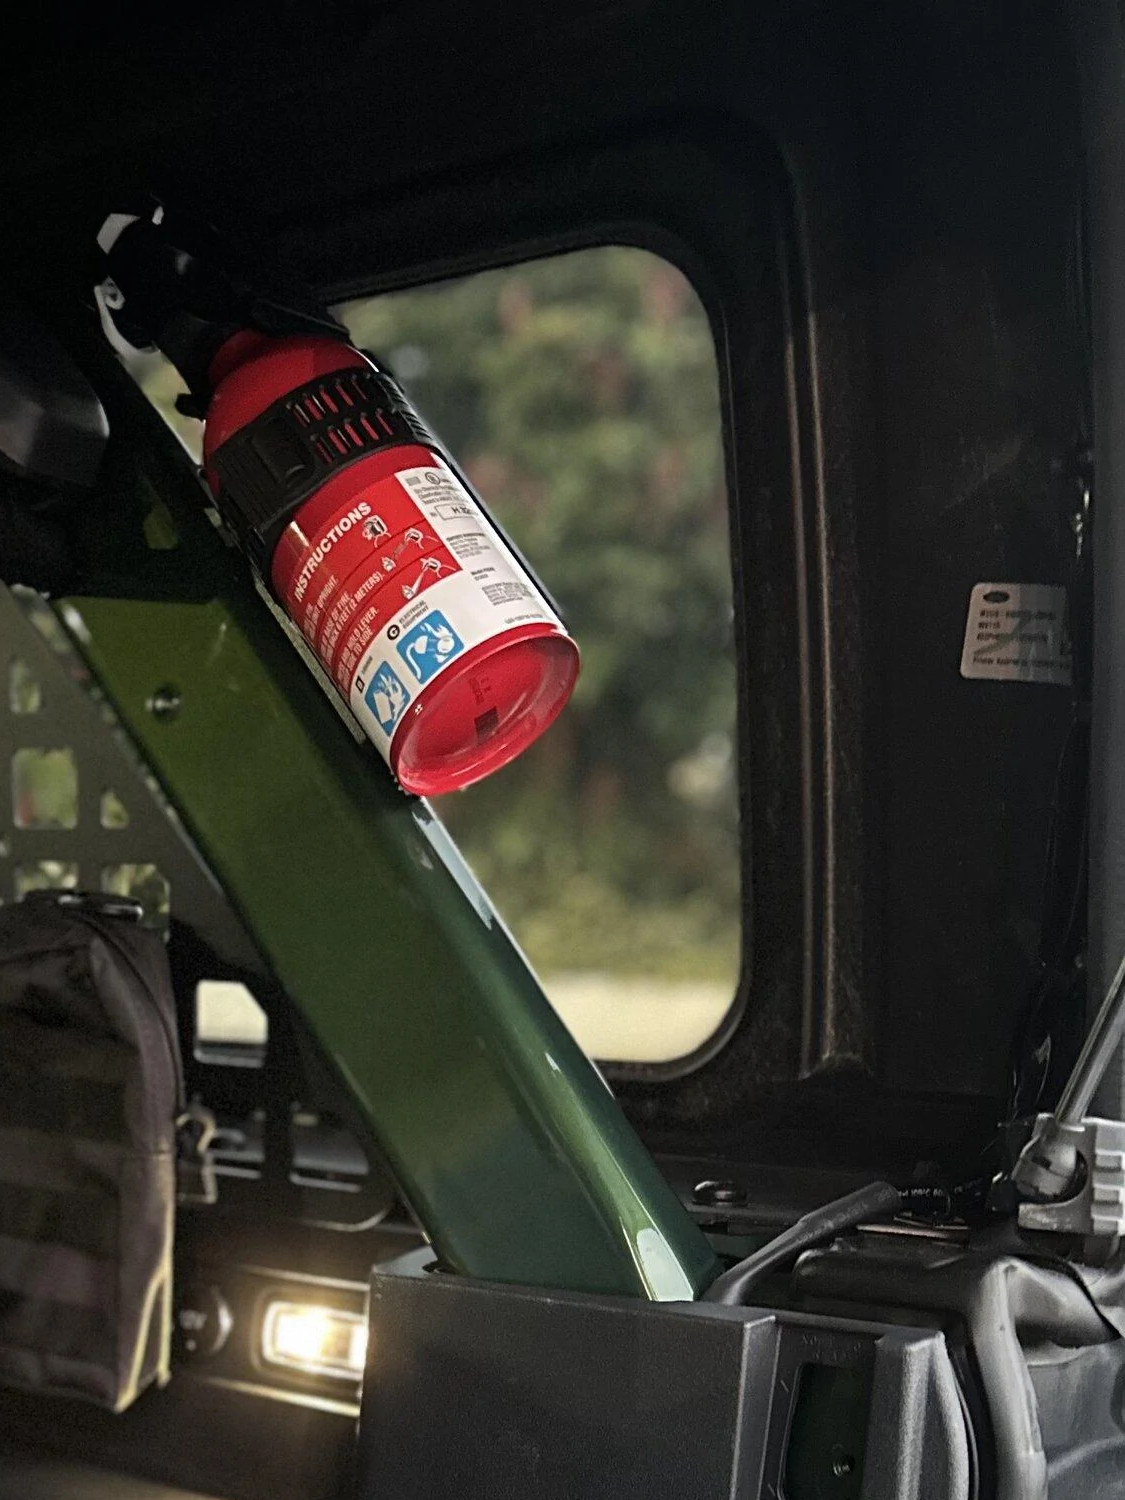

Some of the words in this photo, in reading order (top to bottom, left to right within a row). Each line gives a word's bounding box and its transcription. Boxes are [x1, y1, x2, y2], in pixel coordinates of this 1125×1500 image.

[294, 502, 372, 603] INSTRUCTIONS
[353, 570, 386, 602] METERS).
[357, 606, 379, 632] LEVER.
